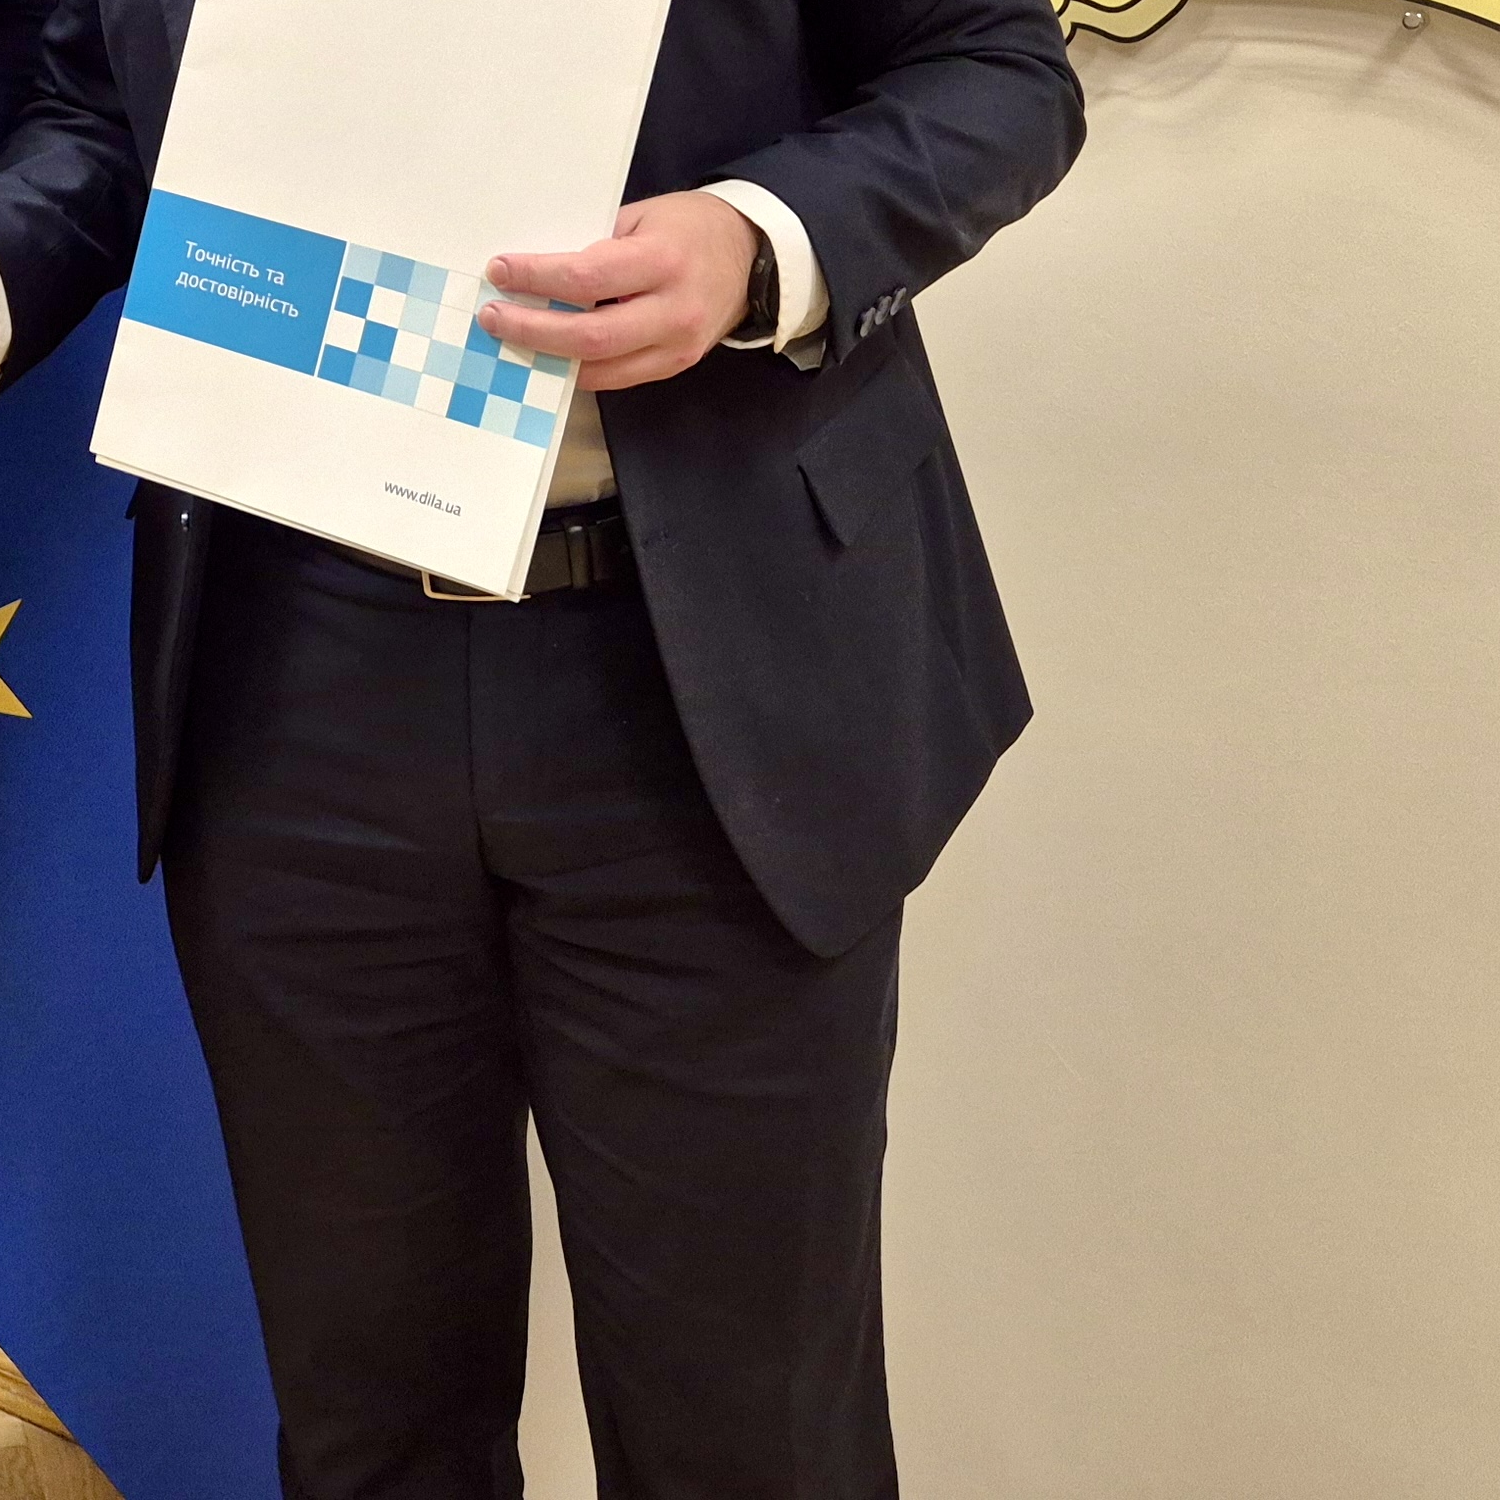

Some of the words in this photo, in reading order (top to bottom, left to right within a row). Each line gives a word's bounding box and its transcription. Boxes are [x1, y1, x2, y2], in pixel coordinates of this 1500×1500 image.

[185, 239, 260, 278] Точність
[266, 268, 285, 286] та
[175, 271, 299, 318] достовірність
[384, 481, 462, 517] www.dila.ua
